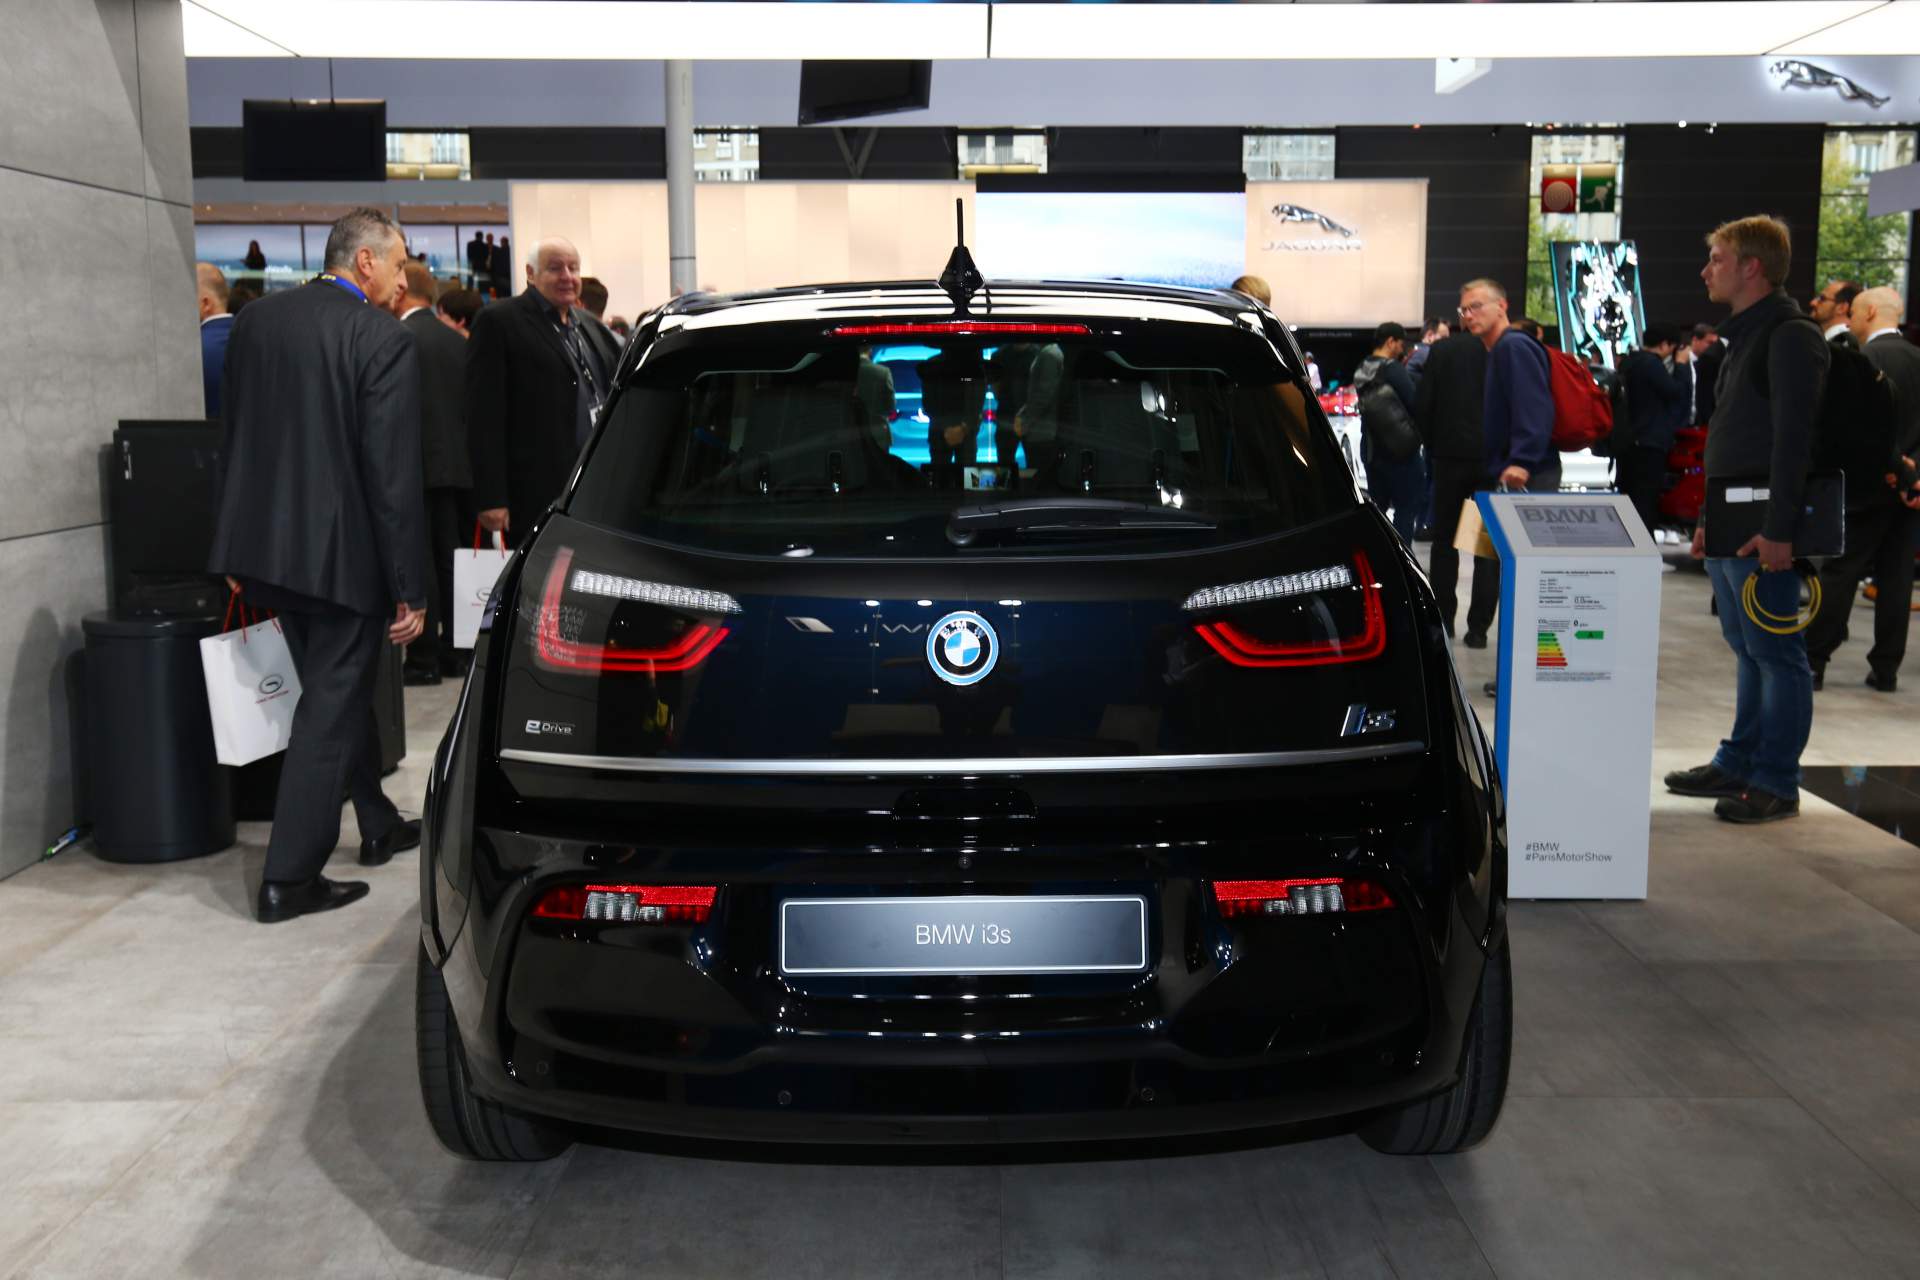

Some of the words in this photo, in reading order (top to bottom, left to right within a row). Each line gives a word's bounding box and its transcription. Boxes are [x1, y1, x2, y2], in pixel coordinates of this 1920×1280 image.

[1261, 240, 1361, 251] JAGUAR
[1522, 507, 1598, 523] BMW
[1526, 842, 1560, 851] #BMW
[1525, 852, 1613, 862] #ParisMotorShow
[916, 924, 975, 945] BMW
[982, 924, 1012, 945] i3s
